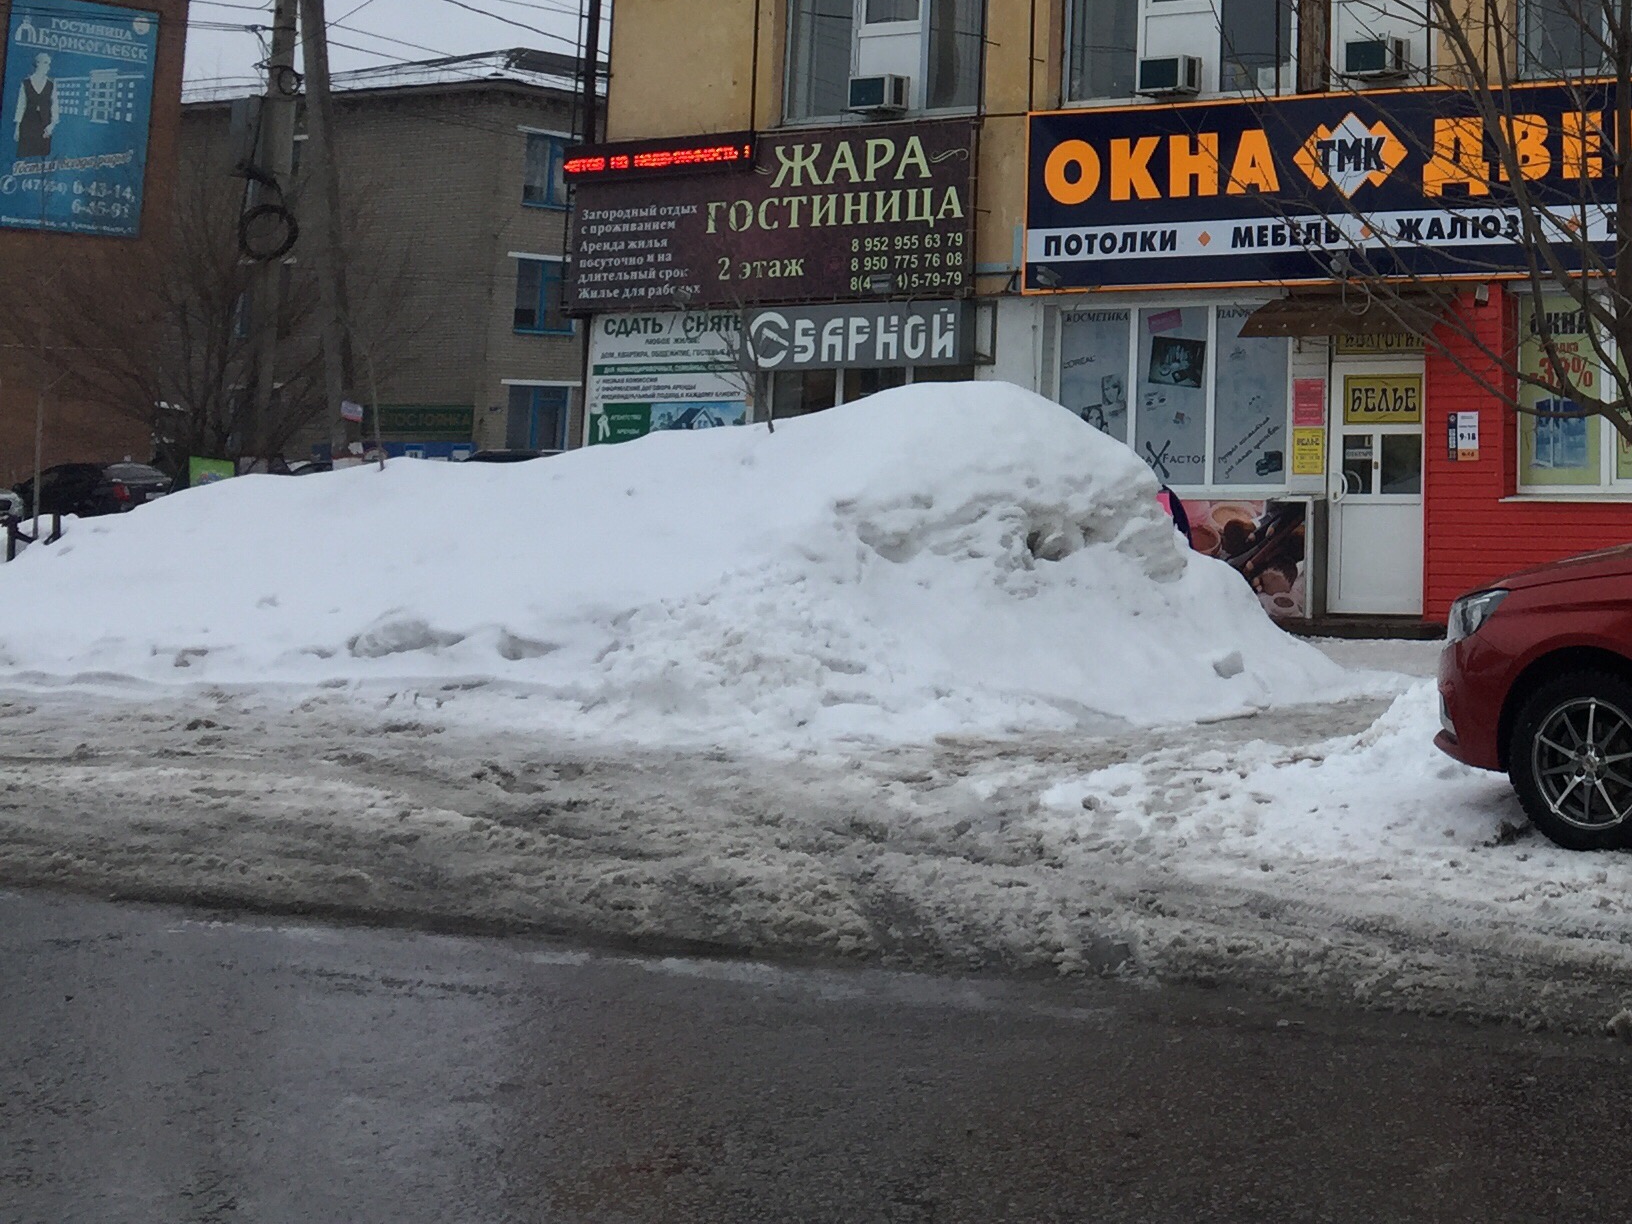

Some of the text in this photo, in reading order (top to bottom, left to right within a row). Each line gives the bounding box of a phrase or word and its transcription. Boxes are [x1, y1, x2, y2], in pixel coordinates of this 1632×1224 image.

[770, 135, 932, 188] ЖАРА
[1044, 128, 1281, 205] ОКНА
[1316, 136, 1387, 173] ТМК
[582, 205, 698, 221] Загородный отдых
[706, 185, 964, 234] ГОСТИНИЦА
[581, 221, 676, 236] с проживанием
[580, 238, 668, 254] Аренда жилья
[851, 232, 963, 252] 8 952 955 63 79
[1044, 228, 1178, 258] ПОТОЛКИ
[1231, 221, 1341, 249] МЕБЕЛЬ
[579, 256, 644, 270] посуточно
[657, 252, 672, 262] на
[717, 257, 804, 280] 2 этаж
[851, 251, 963, 271] 8 950 775 76 08
[577, 268, 690, 284] длительный срок
[910, 271, 963, 287] 5-79-79
[578, 287, 619, 299] Жилье
[622, 287, 645, 299] для
[1065, 311, 1129, 322] КОСМЕТИКА
[603, 317, 663, 337] СДАТЬ
[1351, 387, 1417, 412] БЕЛЬЕ
